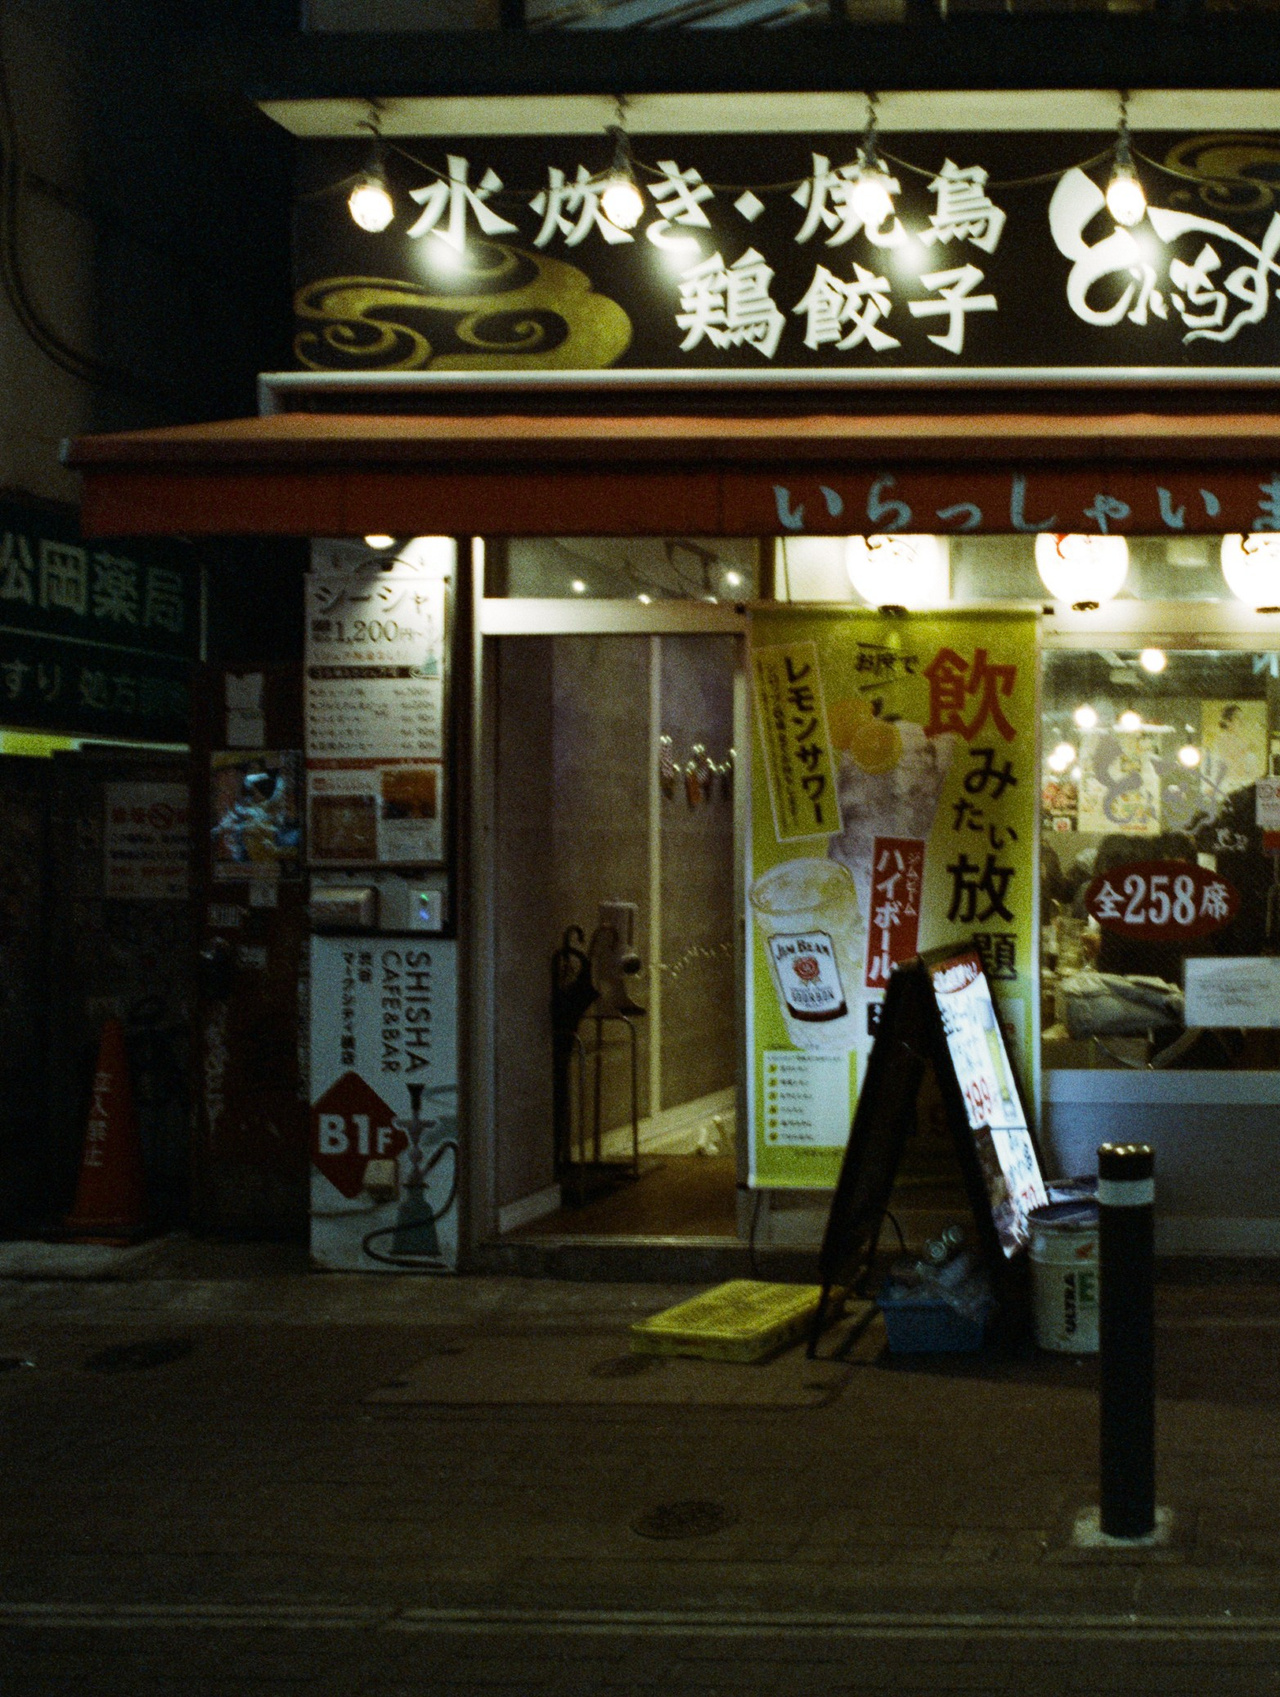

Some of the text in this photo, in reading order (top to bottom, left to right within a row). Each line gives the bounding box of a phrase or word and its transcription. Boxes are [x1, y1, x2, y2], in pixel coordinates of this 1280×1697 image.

[784, 655, 826, 825] レモンサワー
[868, 849, 905, 980] ハイボール
[1093, 874, 1231, 925] 全258席
[404, 950, 432, 1074] SHISHA
[318, 1113, 393, 1155] B1F
